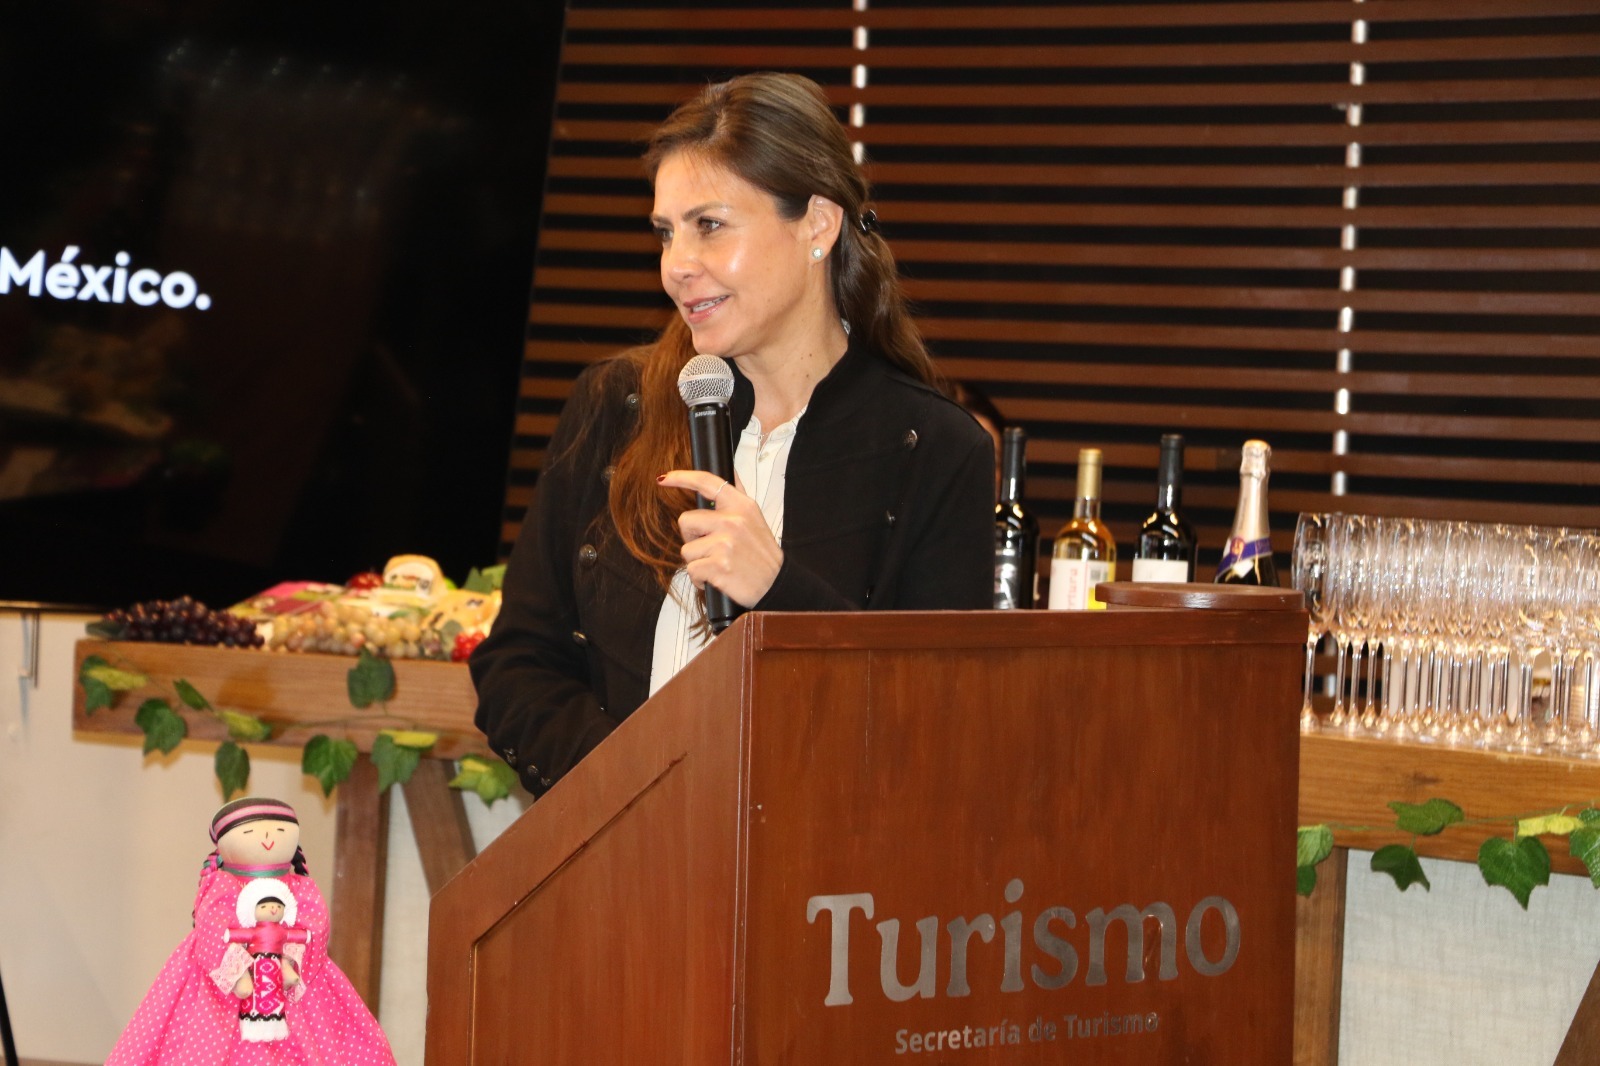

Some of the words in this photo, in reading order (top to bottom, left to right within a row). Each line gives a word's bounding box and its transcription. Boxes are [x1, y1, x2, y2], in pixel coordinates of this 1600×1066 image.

[0, 245, 212, 311] México.
[806, 878, 1241, 1007] Turismo
[895, 1019, 1020, 1055] Secretaría
[1028, 1015, 1057, 1042] de
[1063, 1010, 1159, 1039] Turismo
